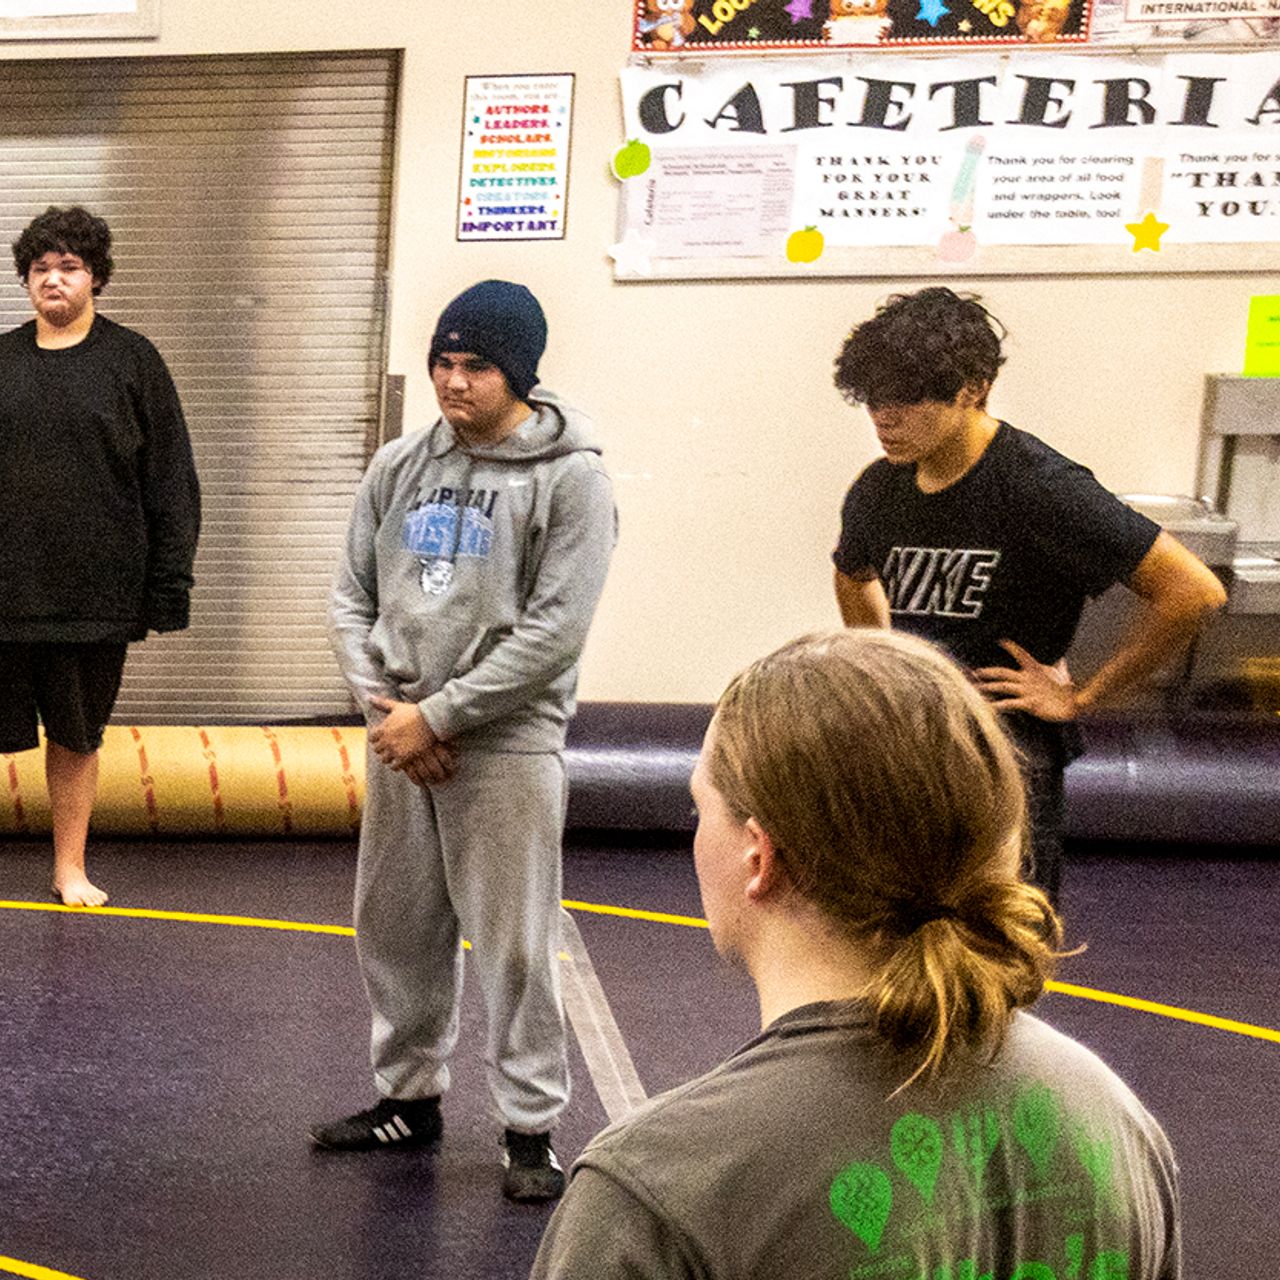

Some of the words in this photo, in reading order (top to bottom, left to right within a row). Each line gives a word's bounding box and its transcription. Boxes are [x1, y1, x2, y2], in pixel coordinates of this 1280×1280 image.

[1141, 2, 1257, 13] INTERNATIONAL
[814, 155, 890, 166] THANK
[901, 155, 942, 166] YOU
[988, 155, 1027, 166] Thank
[1032, 156, 1055, 168] you
[1058, 155, 1077, 165] for
[1081, 155, 1135, 167] clearing
[1179, 153, 1220, 164] Thank
[1223, 154, 1249, 165] you
[1252, 152, 1271, 162] for
[822, 173, 863, 184] FOR
[874, 173, 931, 184] YOUR
[992, 174, 1022, 184] your
[1025, 174, 1056, 183] area
[1059, 173, 1073, 183] of
[1096, 172, 1126, 182] food
[837, 190, 911, 201] GREAT
[992, 191, 1017, 201] and
[1090, 190, 1122, 200] Look
[987, 209, 1025, 219] under
[1029, 209, 1051, 219] the
[883, 546, 1002, 619] NIKE
